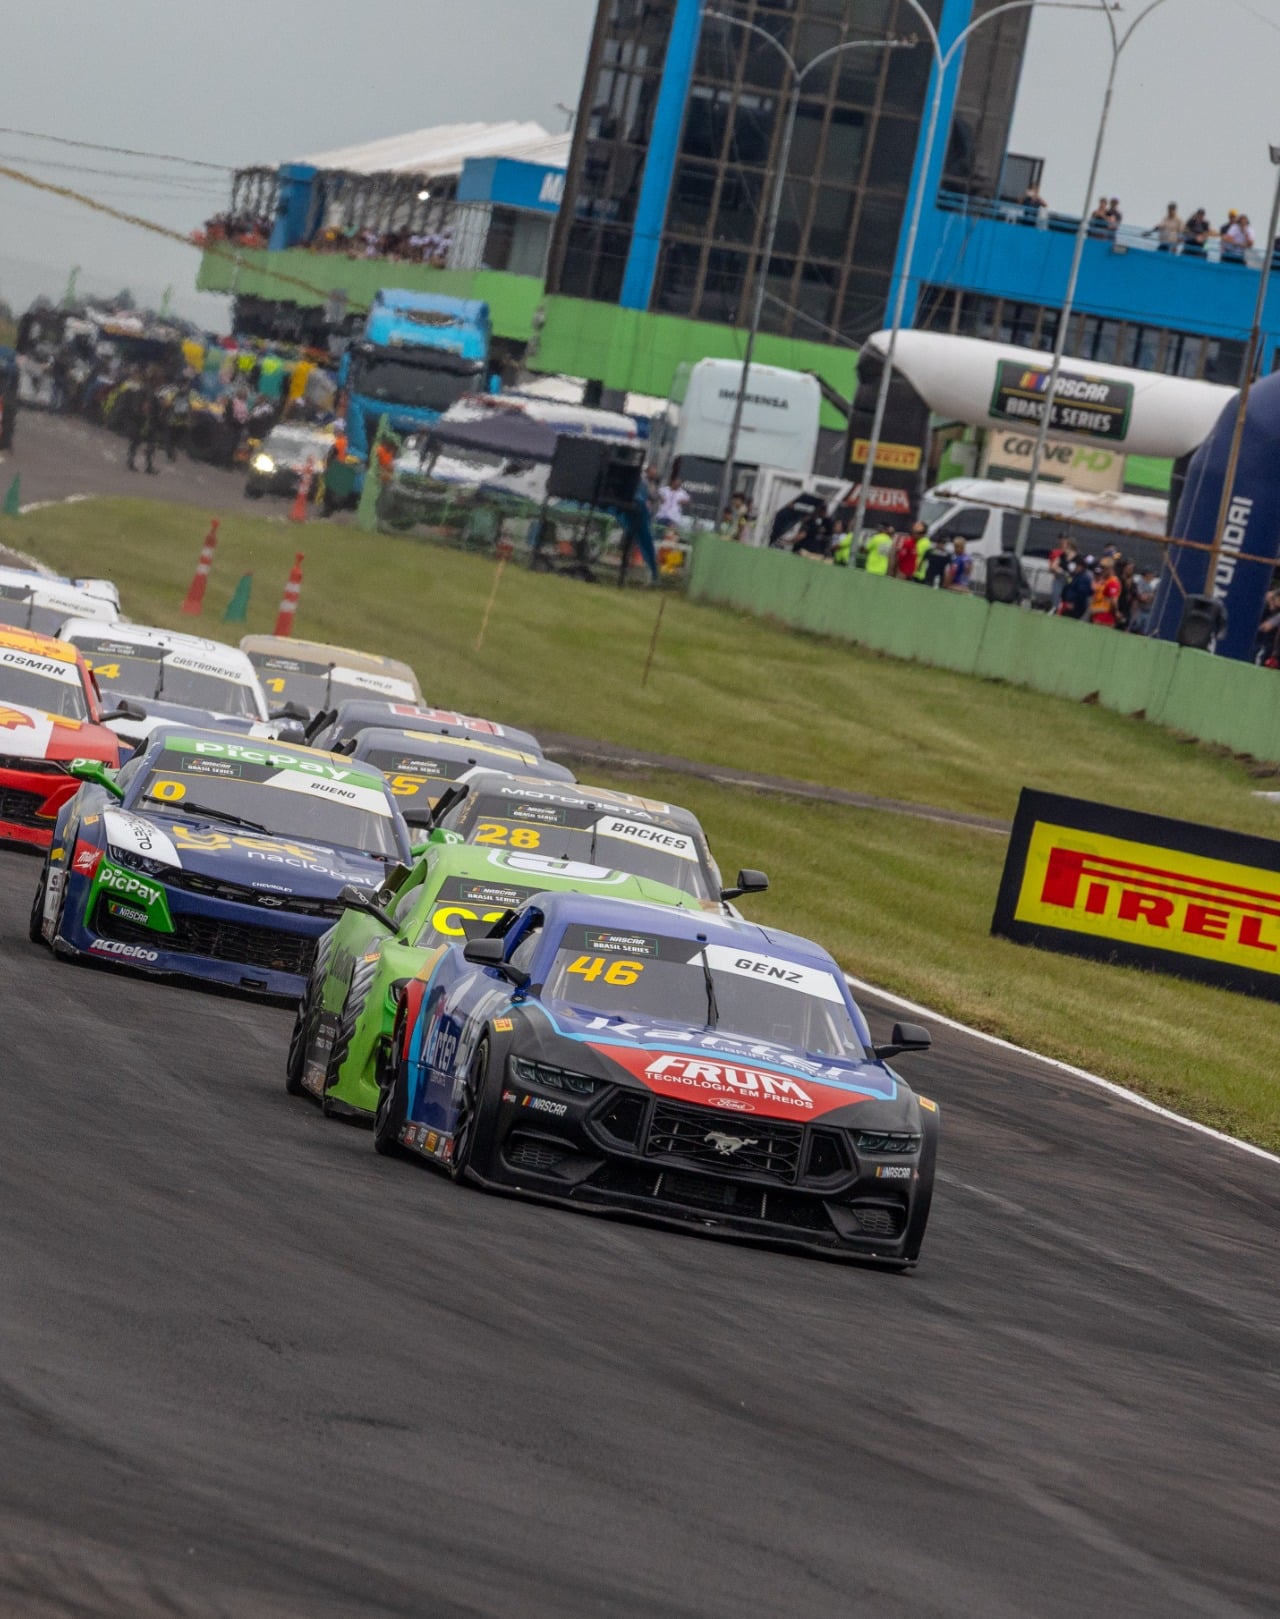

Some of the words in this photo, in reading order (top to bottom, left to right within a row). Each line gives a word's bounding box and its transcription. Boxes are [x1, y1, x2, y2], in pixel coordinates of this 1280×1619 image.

[718, 389, 790, 410] IMRENSA
[1006, 397, 1058, 423] BRASL
[1061, 408, 1113, 432] SERIES
[3, 653, 66, 676] OSMAN
[85, 659, 121, 679] 4
[172, 656, 242, 679] CASTRONEVES
[188, 765, 210, 773] BRASIL
[211, 767, 235, 775] SERIES
[200, 760, 232, 769] NASCAR
[151, 780, 187, 801] 0
[309, 782, 357, 800] BUENO
[384, 774, 428, 795] 5
[475, 822, 541, 849] 28
[611, 822, 689, 850] BACKES
[252, 881, 293, 893] CHEVROLET
[482, 887, 517, 896] NASCAR
[467, 893, 494, 901] BRASIL
[494, 896, 520, 904] SERIES
[119, 907, 149, 924] NASCAR
[90, 939, 159, 962] ACDelco
[593, 942, 622, 951] BRASIL
[622, 945, 650, 954] SERIES
[608, 935, 646, 945] NASCAR
[567, 956, 645, 986] 46
[735, 958, 804, 984] GENZ
[586, 1016, 867, 1077] Karter
[644, 1054, 815, 1103] FRUM
[645, 1071, 736, 1094] TECNOLOGIA
[740, 1088, 760, 1098] EM
[763, 1092, 814, 1110] FREIOS
[534, 1099, 568, 1117] NASCAR
[885, 1166, 910, 1178] NASCAR
